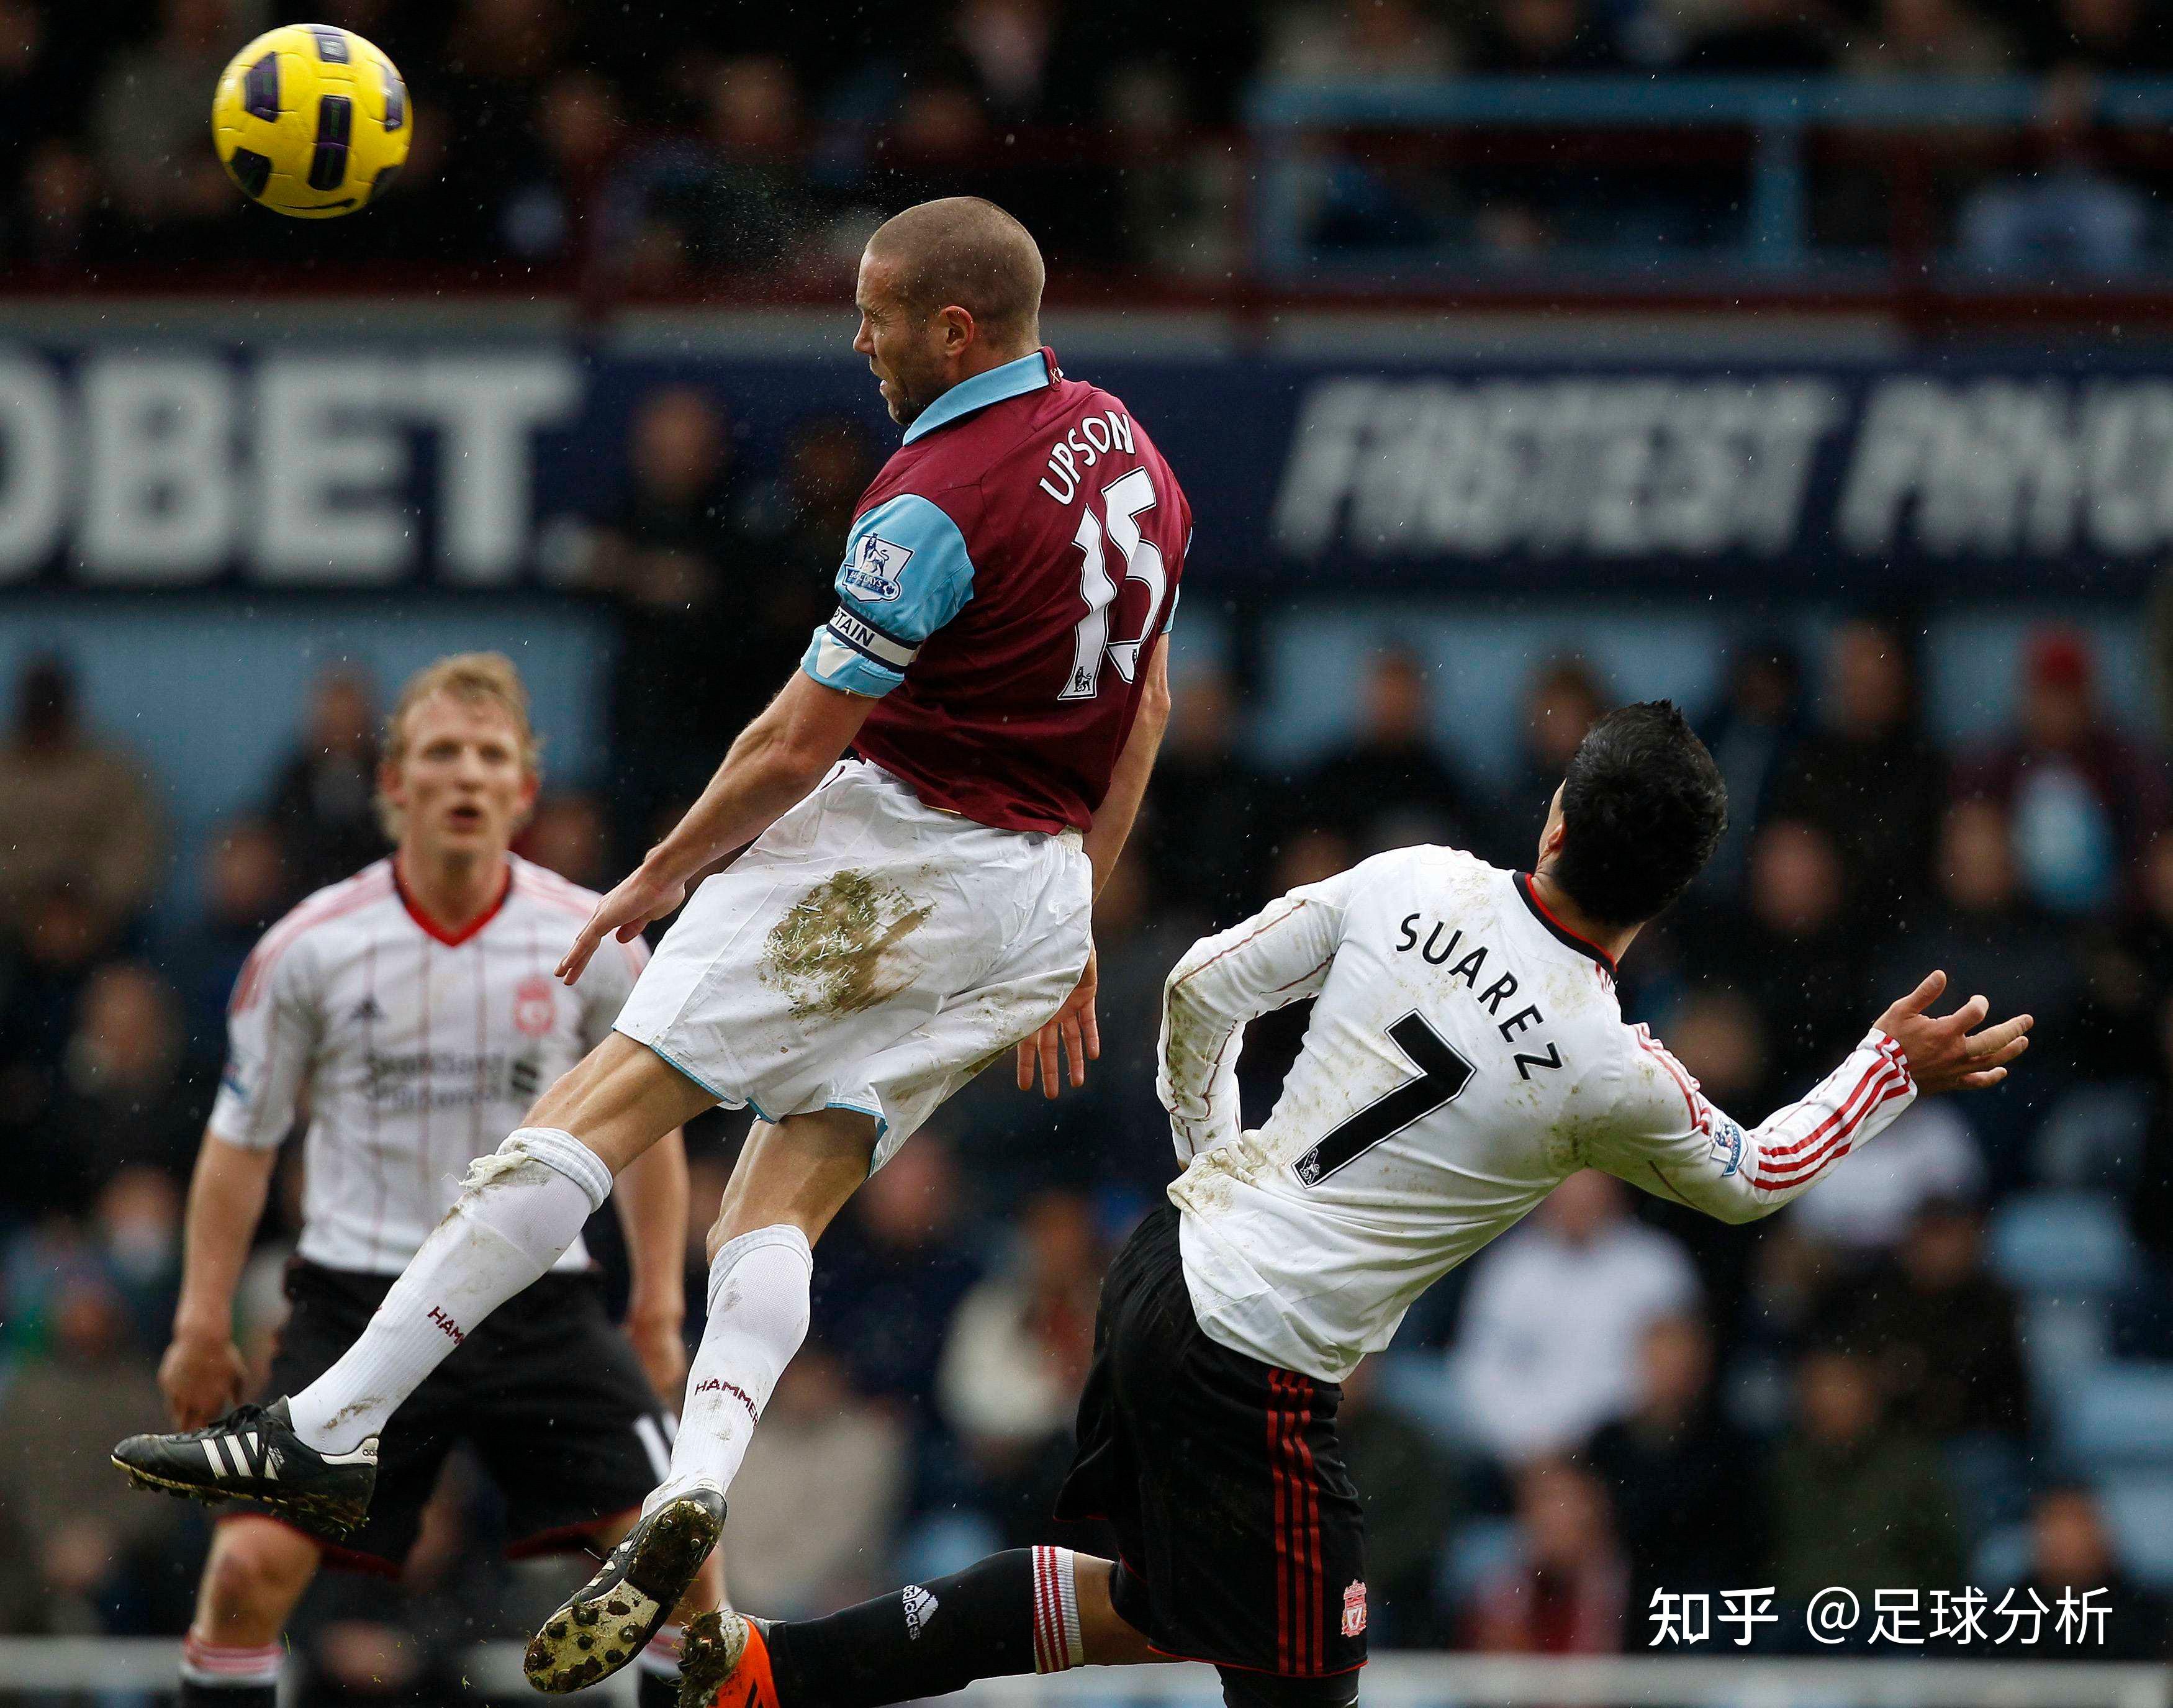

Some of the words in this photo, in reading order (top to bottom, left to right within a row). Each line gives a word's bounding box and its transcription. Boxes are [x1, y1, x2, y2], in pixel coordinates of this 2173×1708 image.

[1039, 410, 1136, 505] UPSON
[1058, 466, 1167, 700] 15
[1396, 912, 1563, 1081] SUAREZ
[1291, 1008, 1477, 1188] 7
[427, 1305, 466, 1346] HAM
[902, 1584, 921, 1641] adidas
